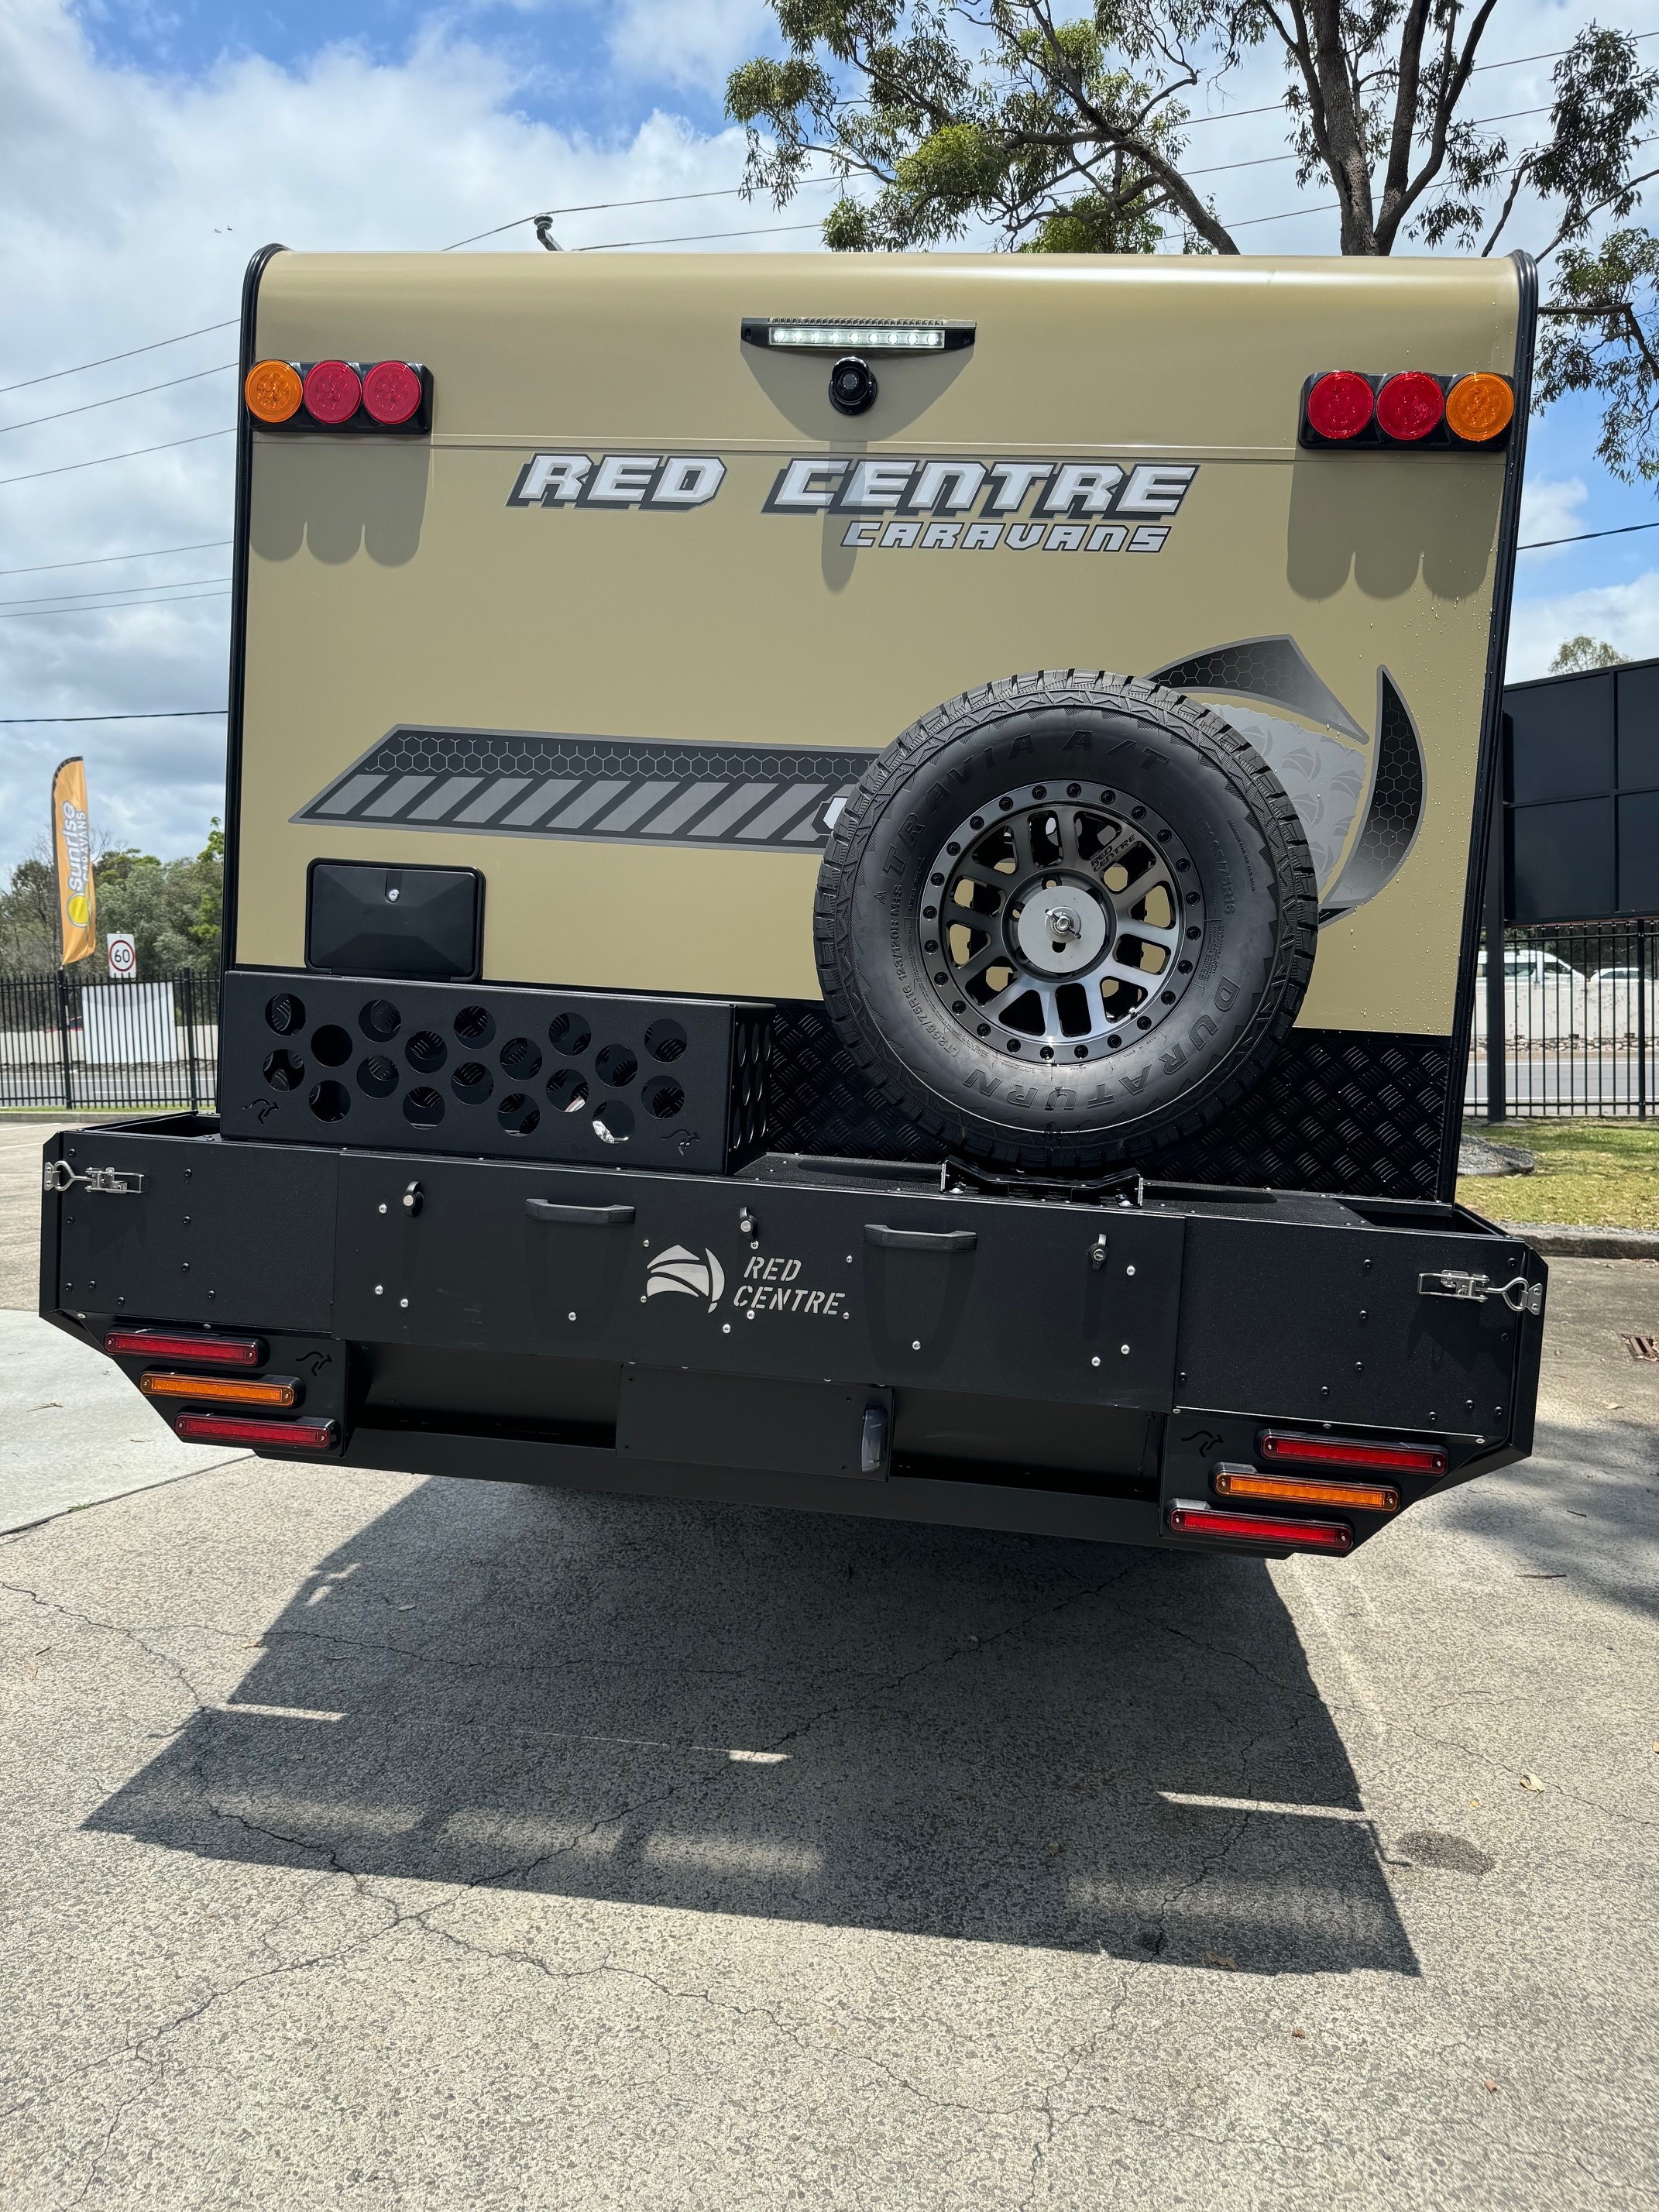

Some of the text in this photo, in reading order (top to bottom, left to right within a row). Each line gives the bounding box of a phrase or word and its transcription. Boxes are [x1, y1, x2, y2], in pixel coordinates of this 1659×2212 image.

[505, 452, 1201, 521] RED CENTRE
[840, 521, 1172, 552] CARAVANS
[881, 730, 1170, 876] TRAVIA A/T
[1091, 845, 1113, 867] RED
[1093, 833, 1135, 872] CENTRE
[114, 949, 130, 963] 60
[902, 984, 959, 1059] LT265/75R16
[963, 974, 1242, 1111] DURATURN
[744, 1256, 802, 1281] RED
[733, 1285, 846, 1314] CENTRE
